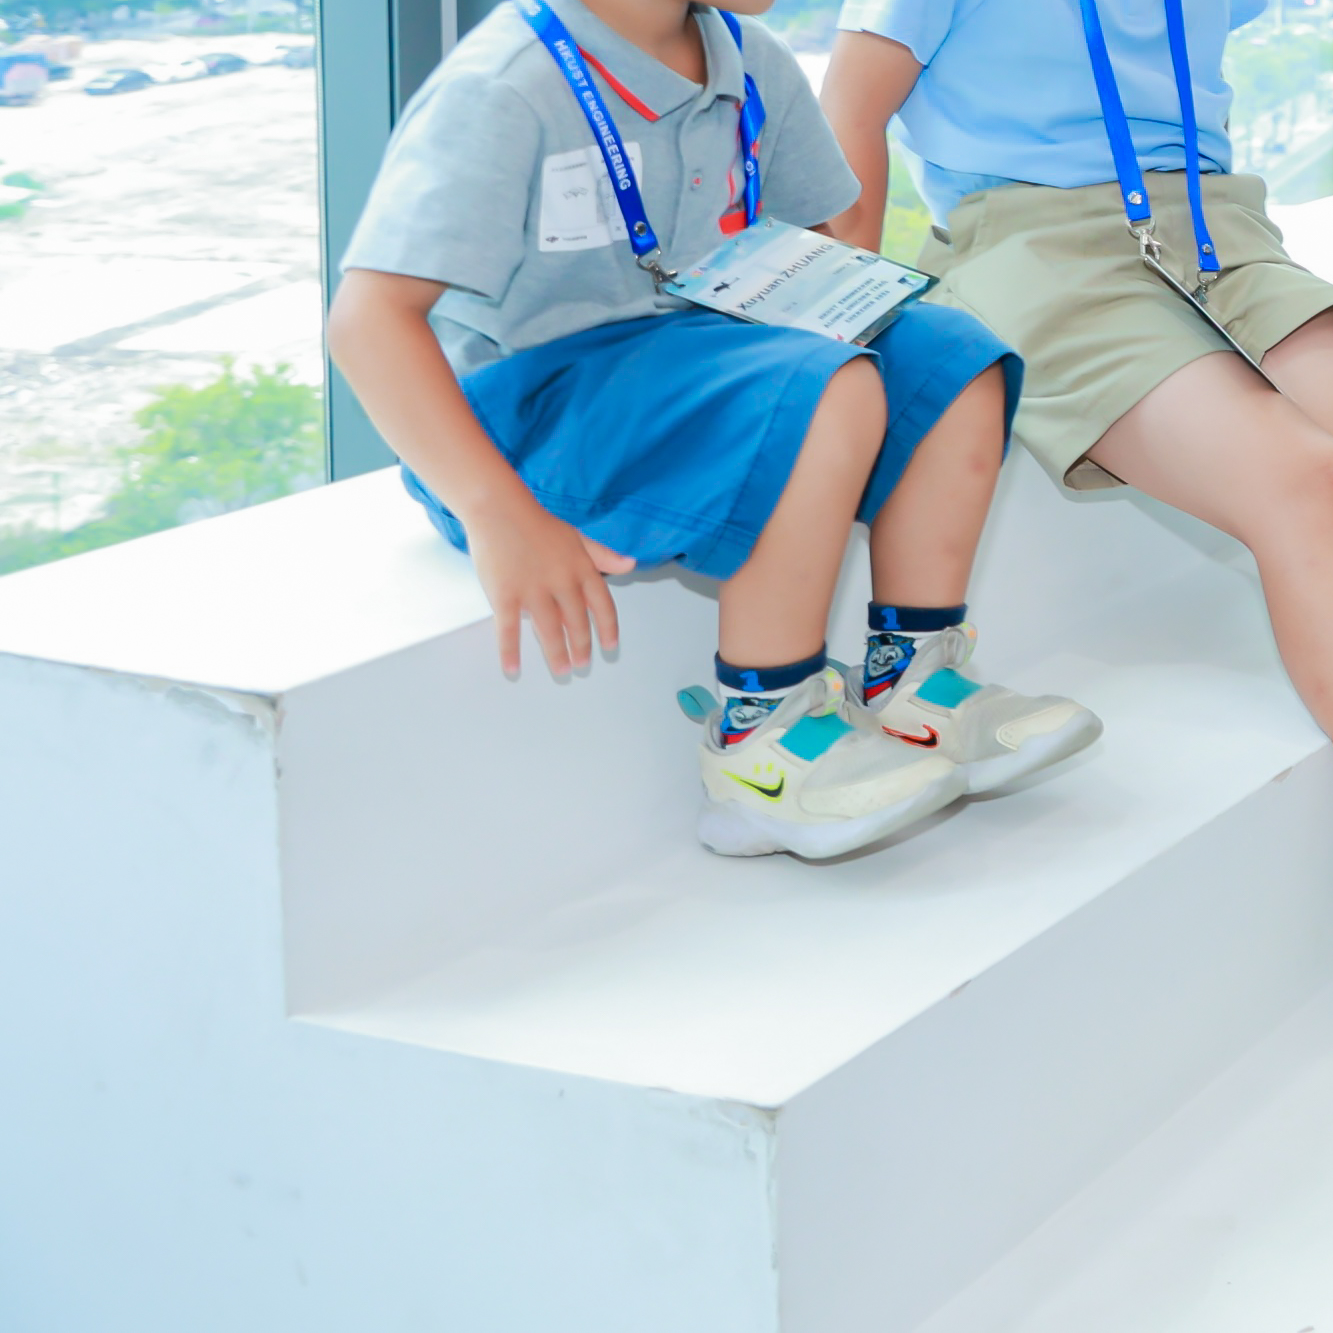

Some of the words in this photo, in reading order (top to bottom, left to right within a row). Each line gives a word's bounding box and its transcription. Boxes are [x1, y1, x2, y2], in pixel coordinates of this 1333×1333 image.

[554, 39, 589, 89] HKUST
[582, 89, 631, 191] ENGINEERING
[736, 277, 785, 312] Xuyuan
[780, 243, 835, 279] ZHUANG
[880, 607, 901, 630] 1
[739, 670, 765, 692] 1
